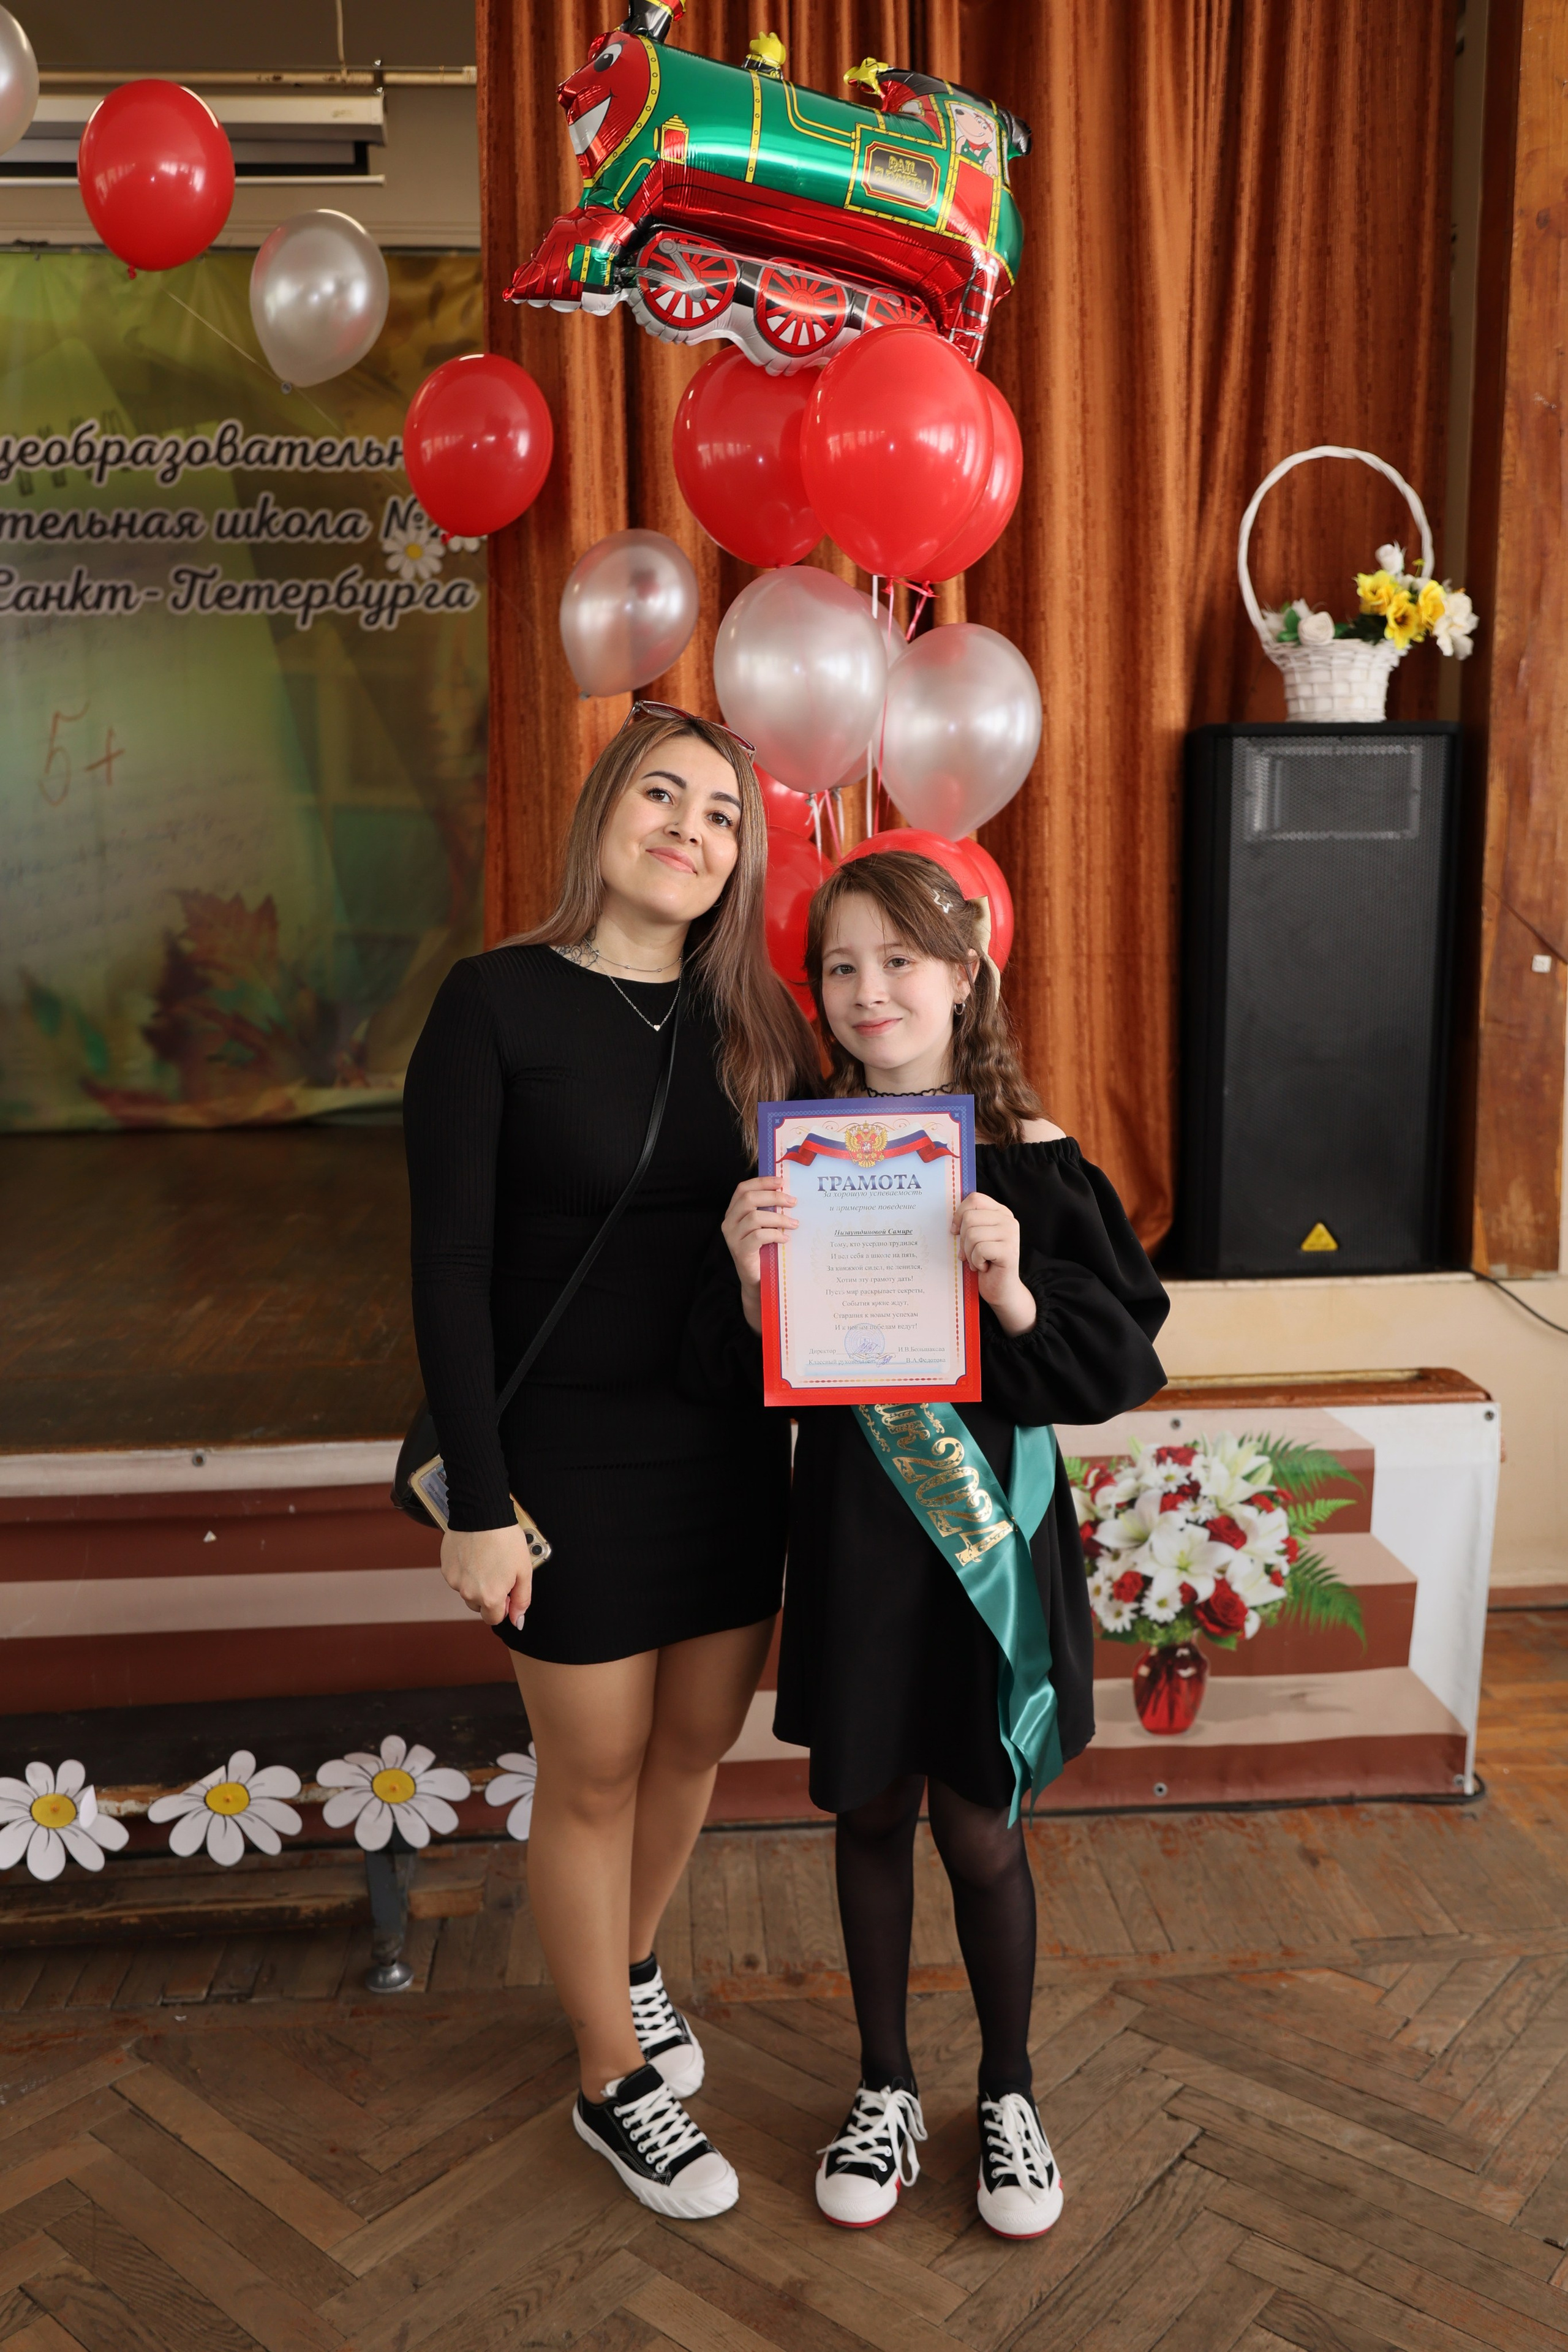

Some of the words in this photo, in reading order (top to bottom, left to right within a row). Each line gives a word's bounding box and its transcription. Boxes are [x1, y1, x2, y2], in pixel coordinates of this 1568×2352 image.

[888, 156, 918, 176] RAIL
[0, 510, 203, 540] тельная
[217, 495, 369, 540] школа
[817, 1174, 922, 1191] ГРАМОТА
[892, 1437, 1013, 1566] 2024
